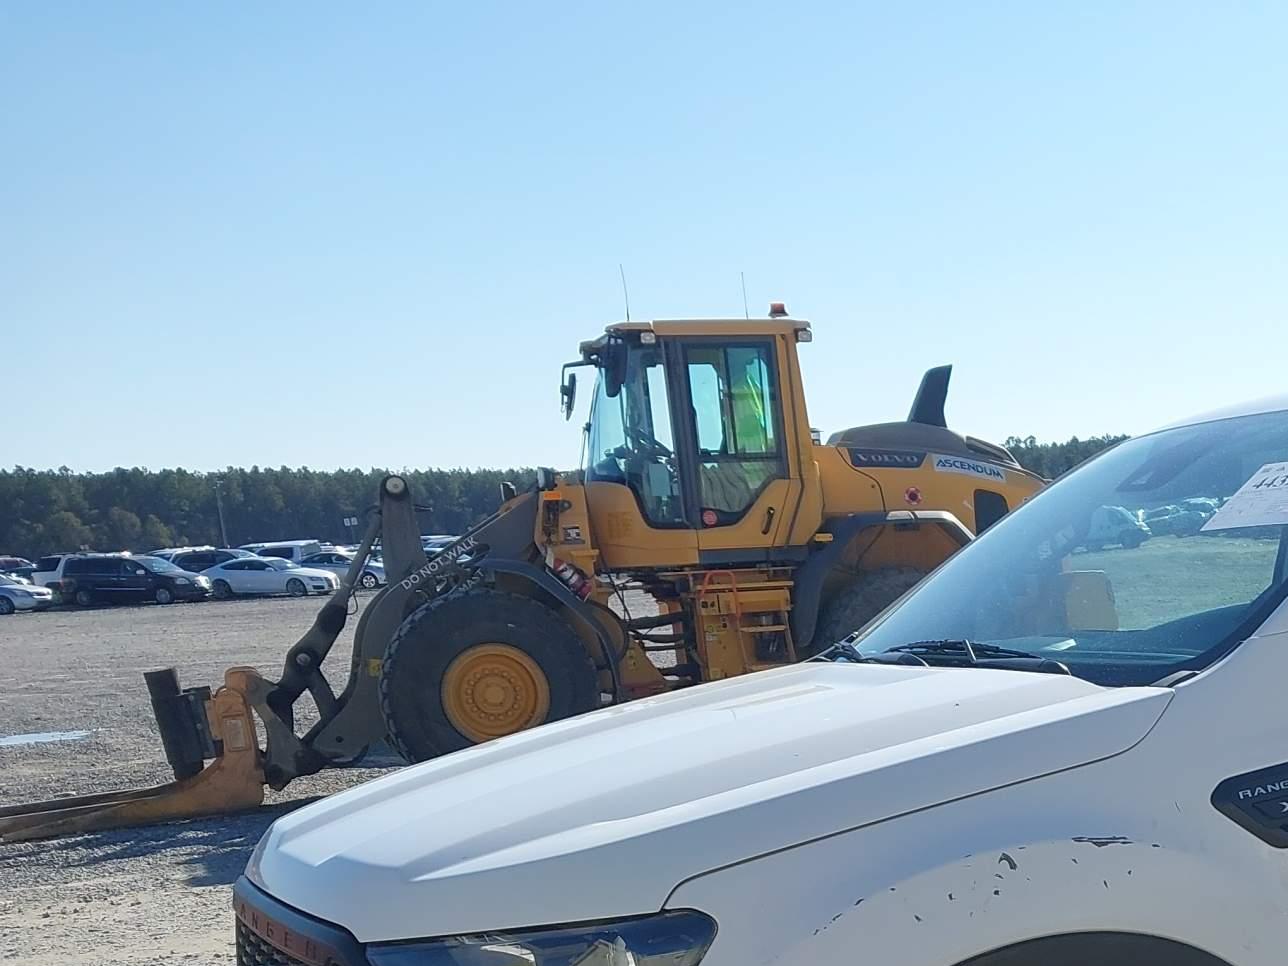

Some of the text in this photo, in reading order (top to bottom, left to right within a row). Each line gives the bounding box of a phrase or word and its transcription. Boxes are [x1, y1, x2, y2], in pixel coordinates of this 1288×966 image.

[856, 453, 918, 464] VOLVO
[936, 458, 1003, 480] ASCENDUM
[401, 536, 478, 590] DO NOT WALK
